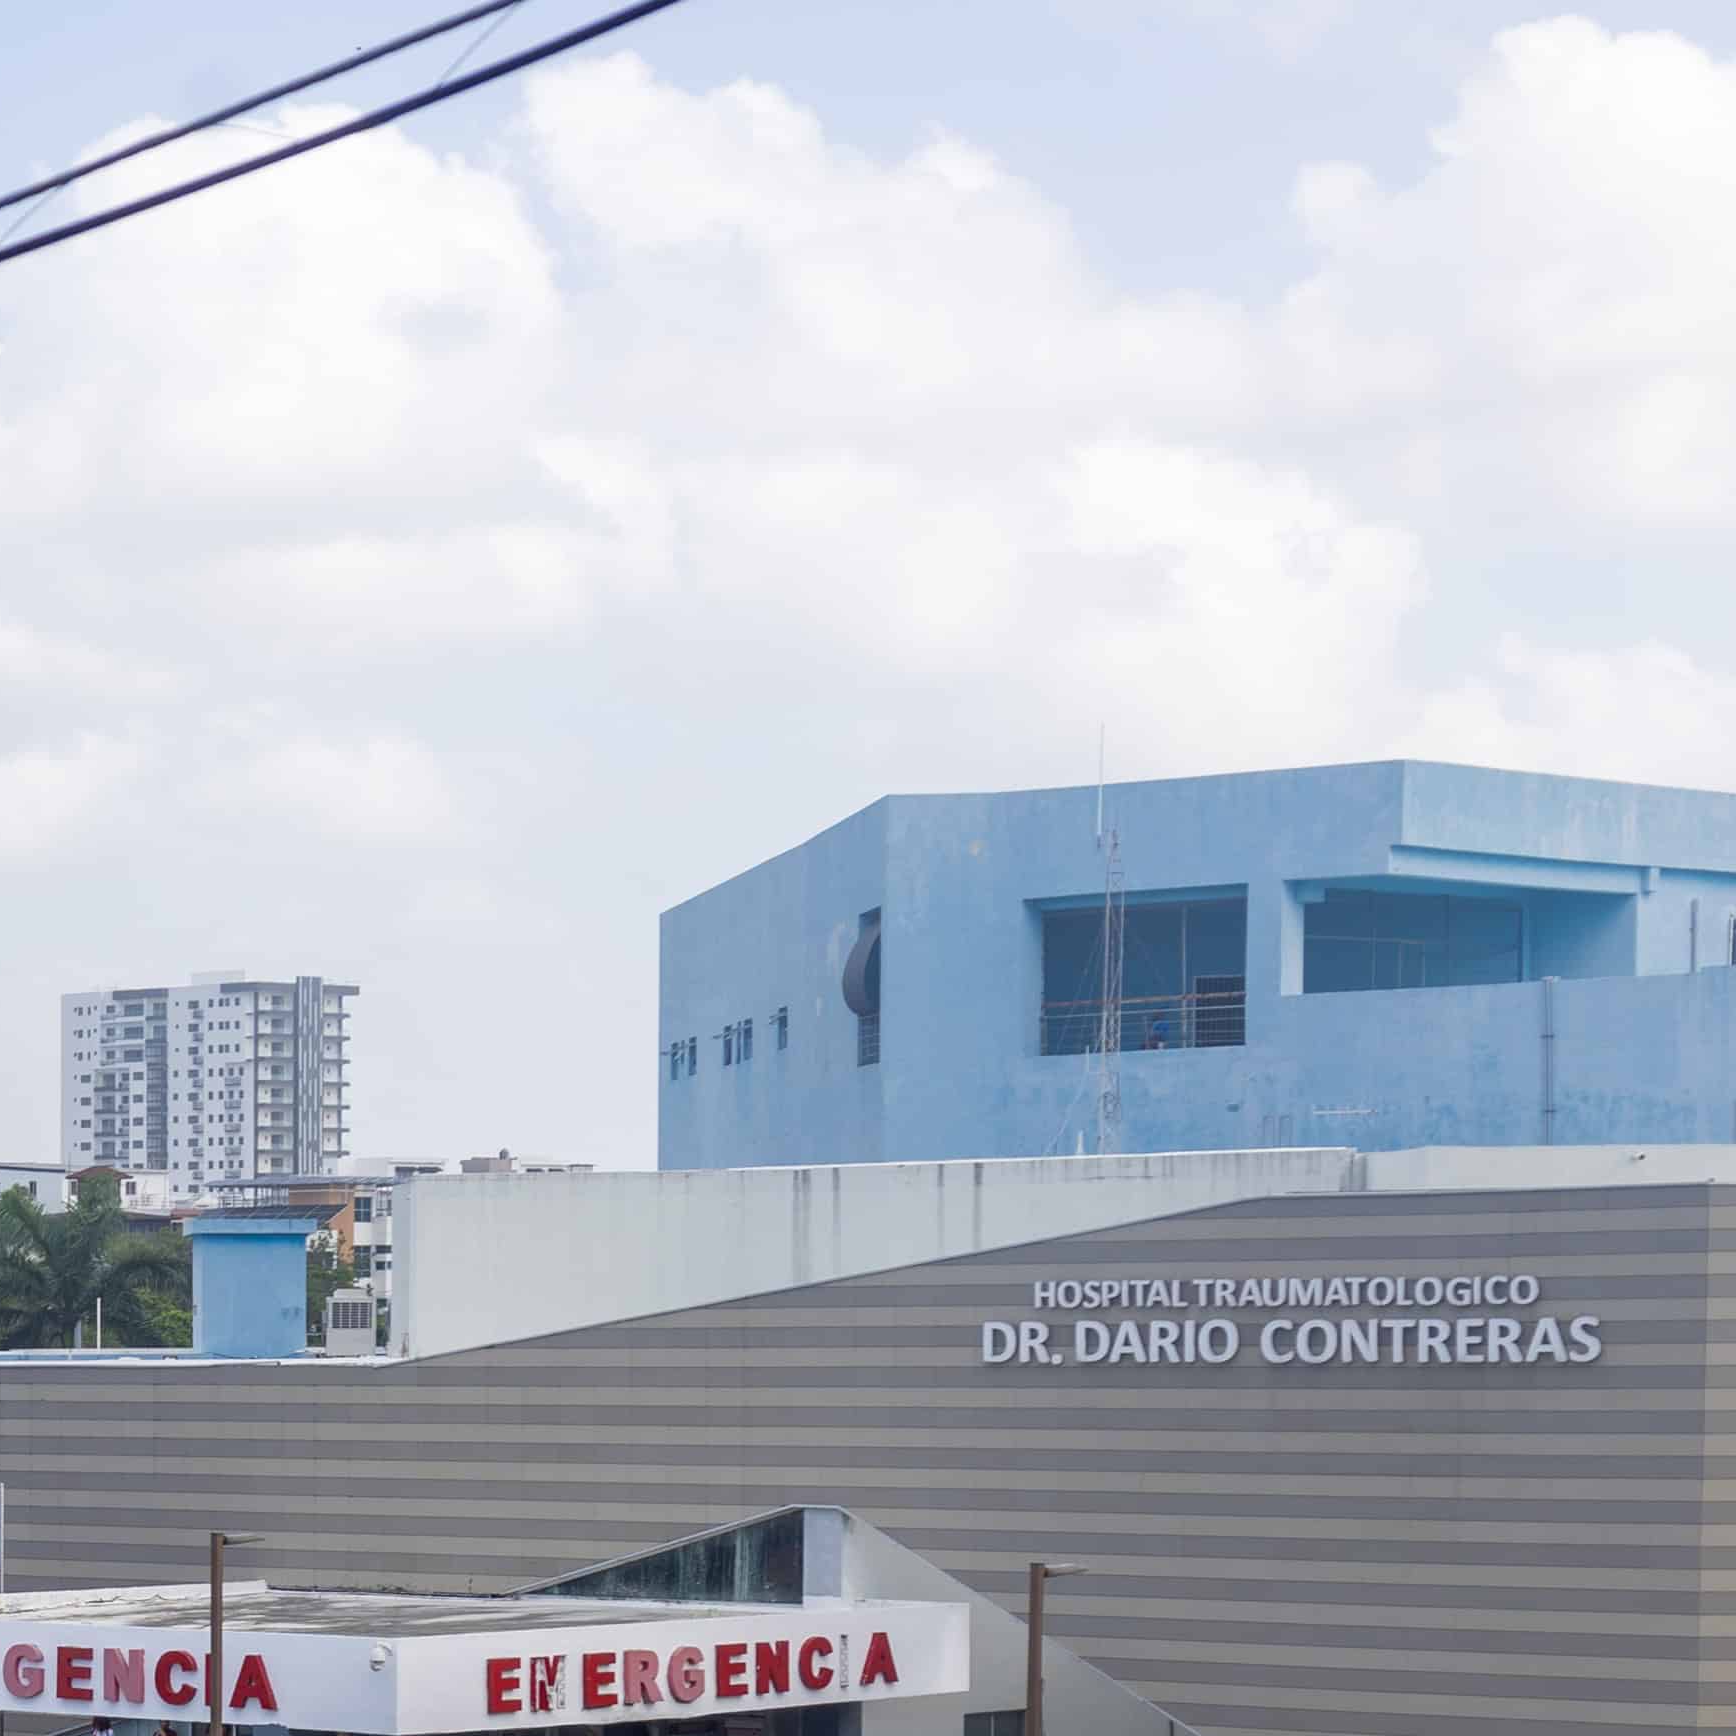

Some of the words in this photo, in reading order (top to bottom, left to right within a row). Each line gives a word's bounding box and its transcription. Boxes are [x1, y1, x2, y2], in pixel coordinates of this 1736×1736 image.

[1033, 1279, 1188, 1309] HOSPITAL
[1193, 1275, 1540, 1307] TRAUMATOLOGICO
[981, 1320, 1063, 1365] DR.
[1074, 1318, 1239, 1365] DARIO
[1259, 1315, 1602, 1365] CONTRERAS
[486, 1631, 899, 1714] EMERGENCIA
